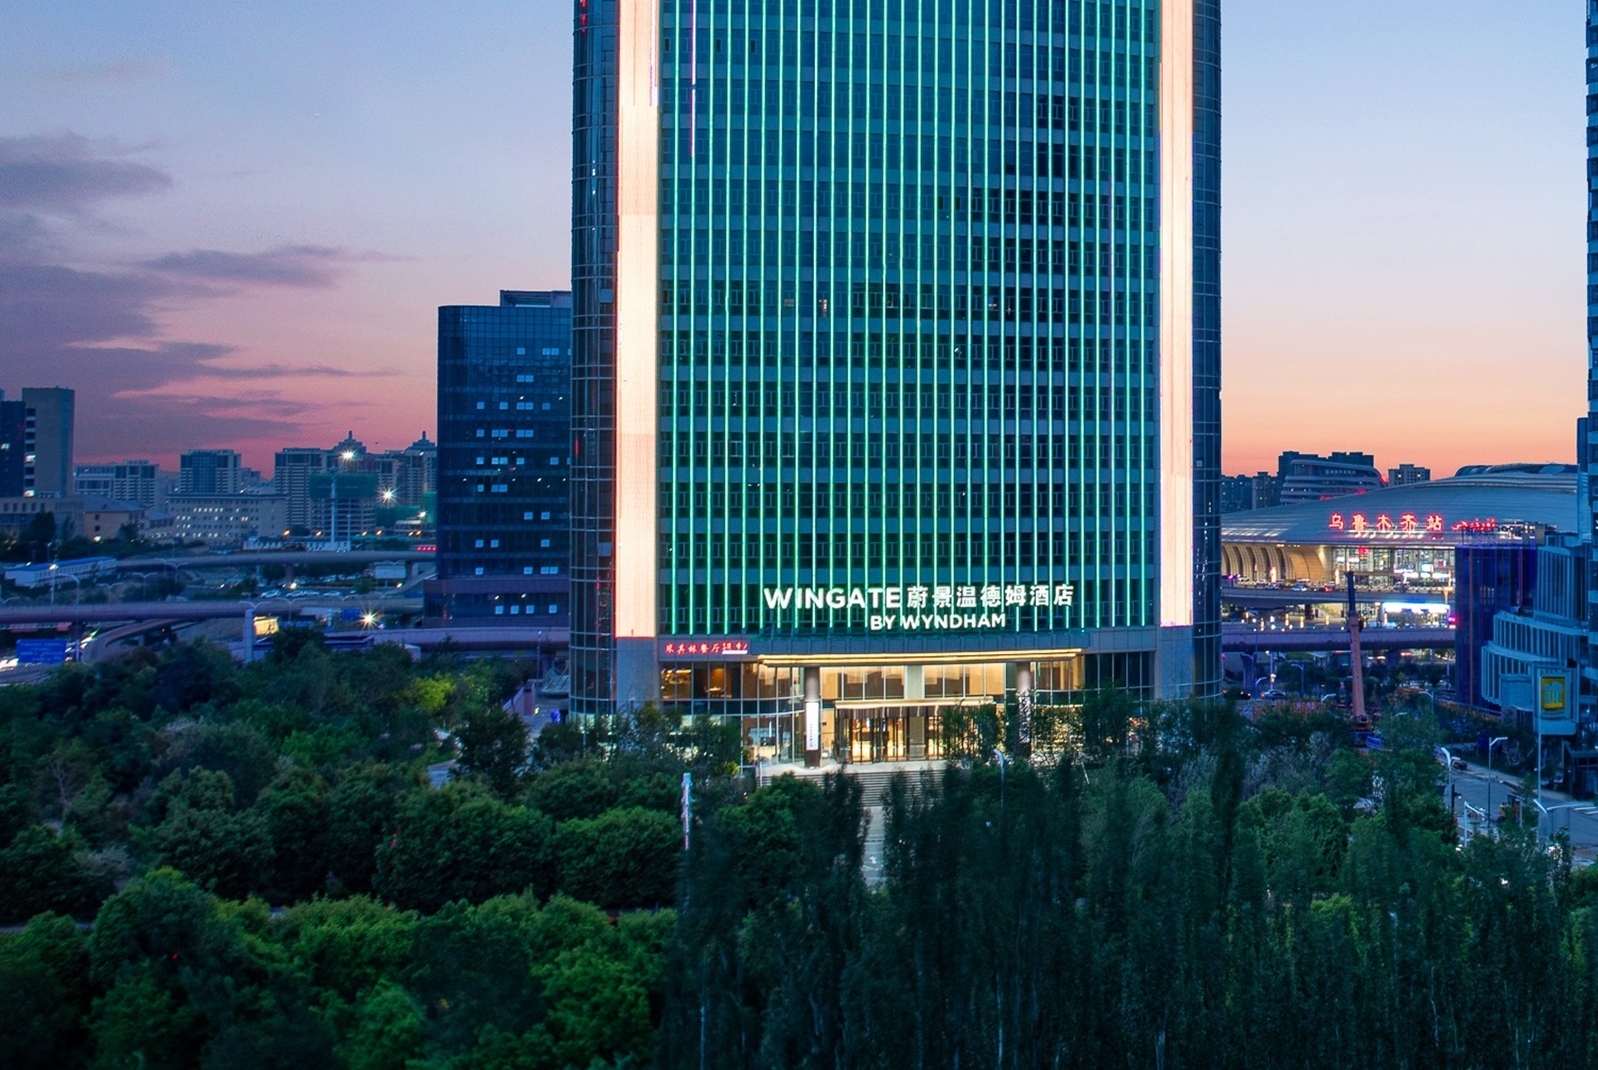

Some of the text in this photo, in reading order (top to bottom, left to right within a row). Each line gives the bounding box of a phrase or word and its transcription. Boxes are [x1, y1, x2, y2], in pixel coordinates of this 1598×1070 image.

[1328, 514, 1443, 533] 乌鲁木齐站
[763, 584, 1075, 610] WINGATE 蔚景温德姆酒店
[870, 613, 1007, 631] BY WYNDHAM
